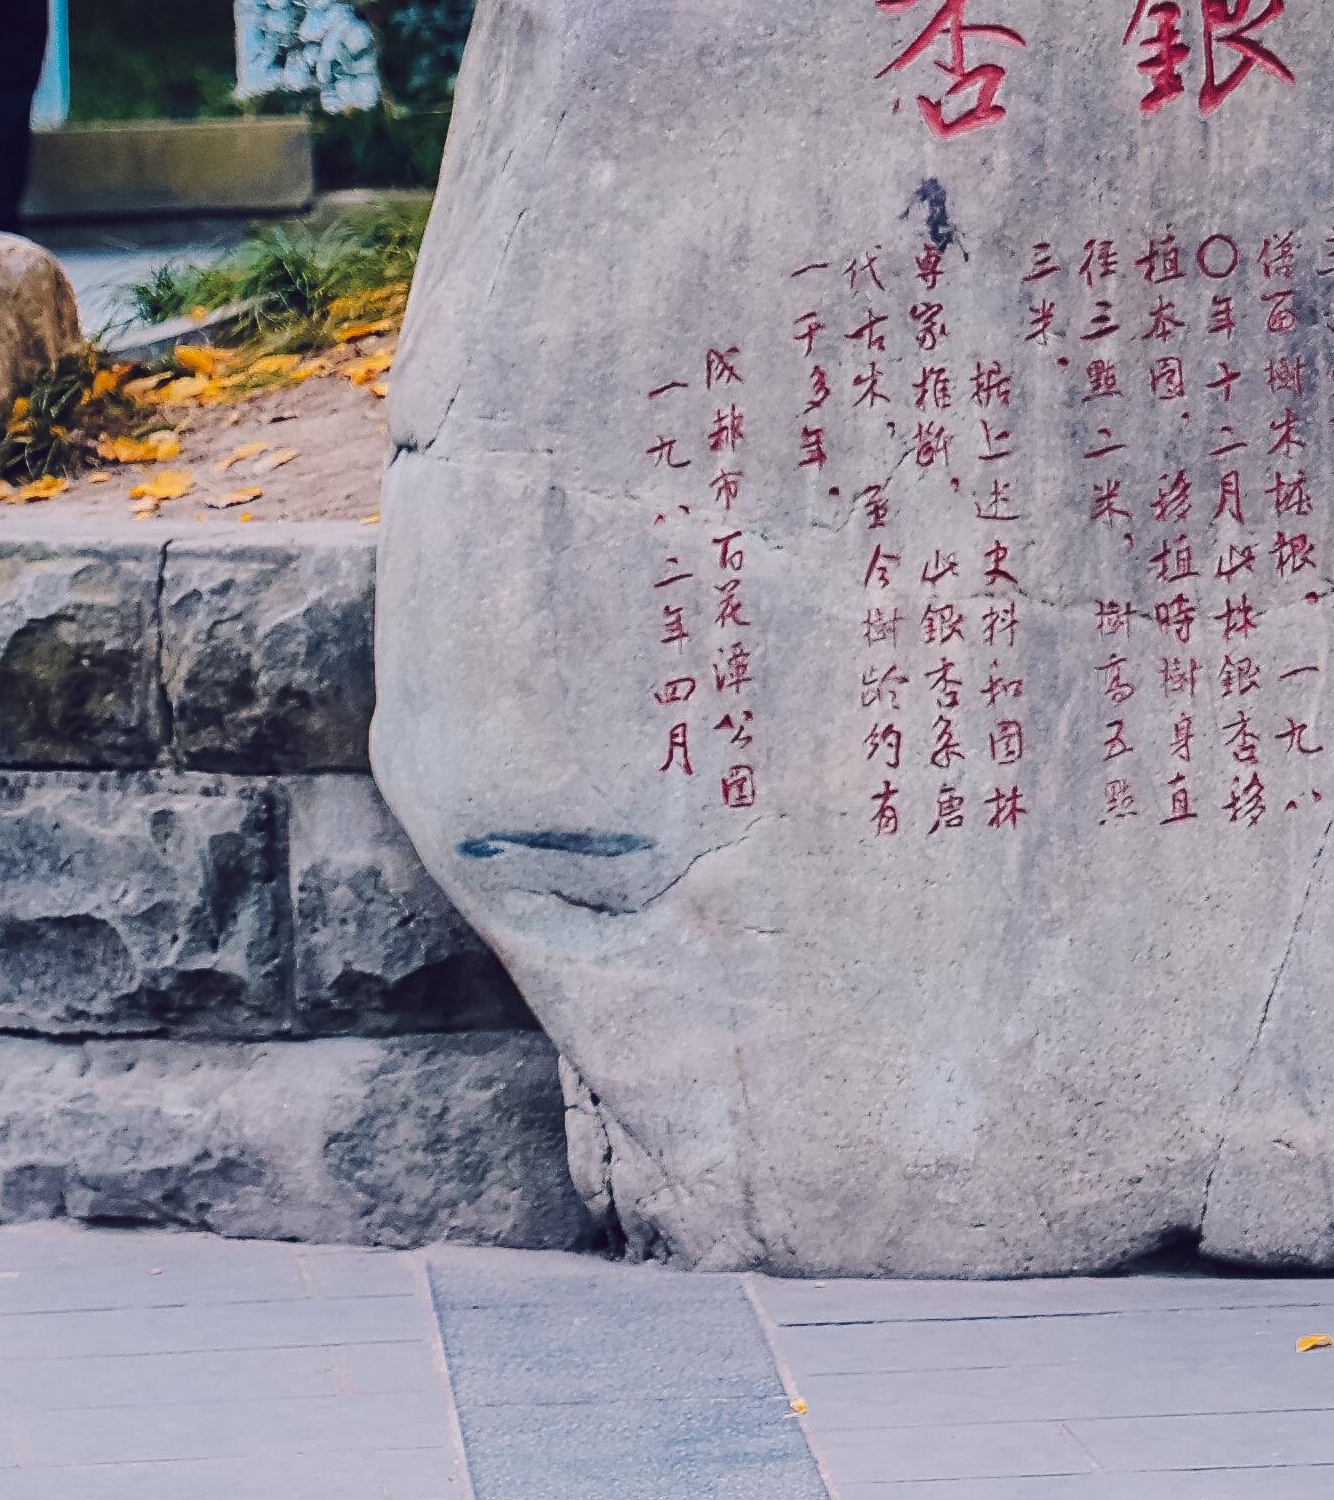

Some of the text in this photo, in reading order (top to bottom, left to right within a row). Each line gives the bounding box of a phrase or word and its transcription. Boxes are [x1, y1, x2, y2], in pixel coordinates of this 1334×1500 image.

[646, 381, 696, 776] 一九八二年四月
